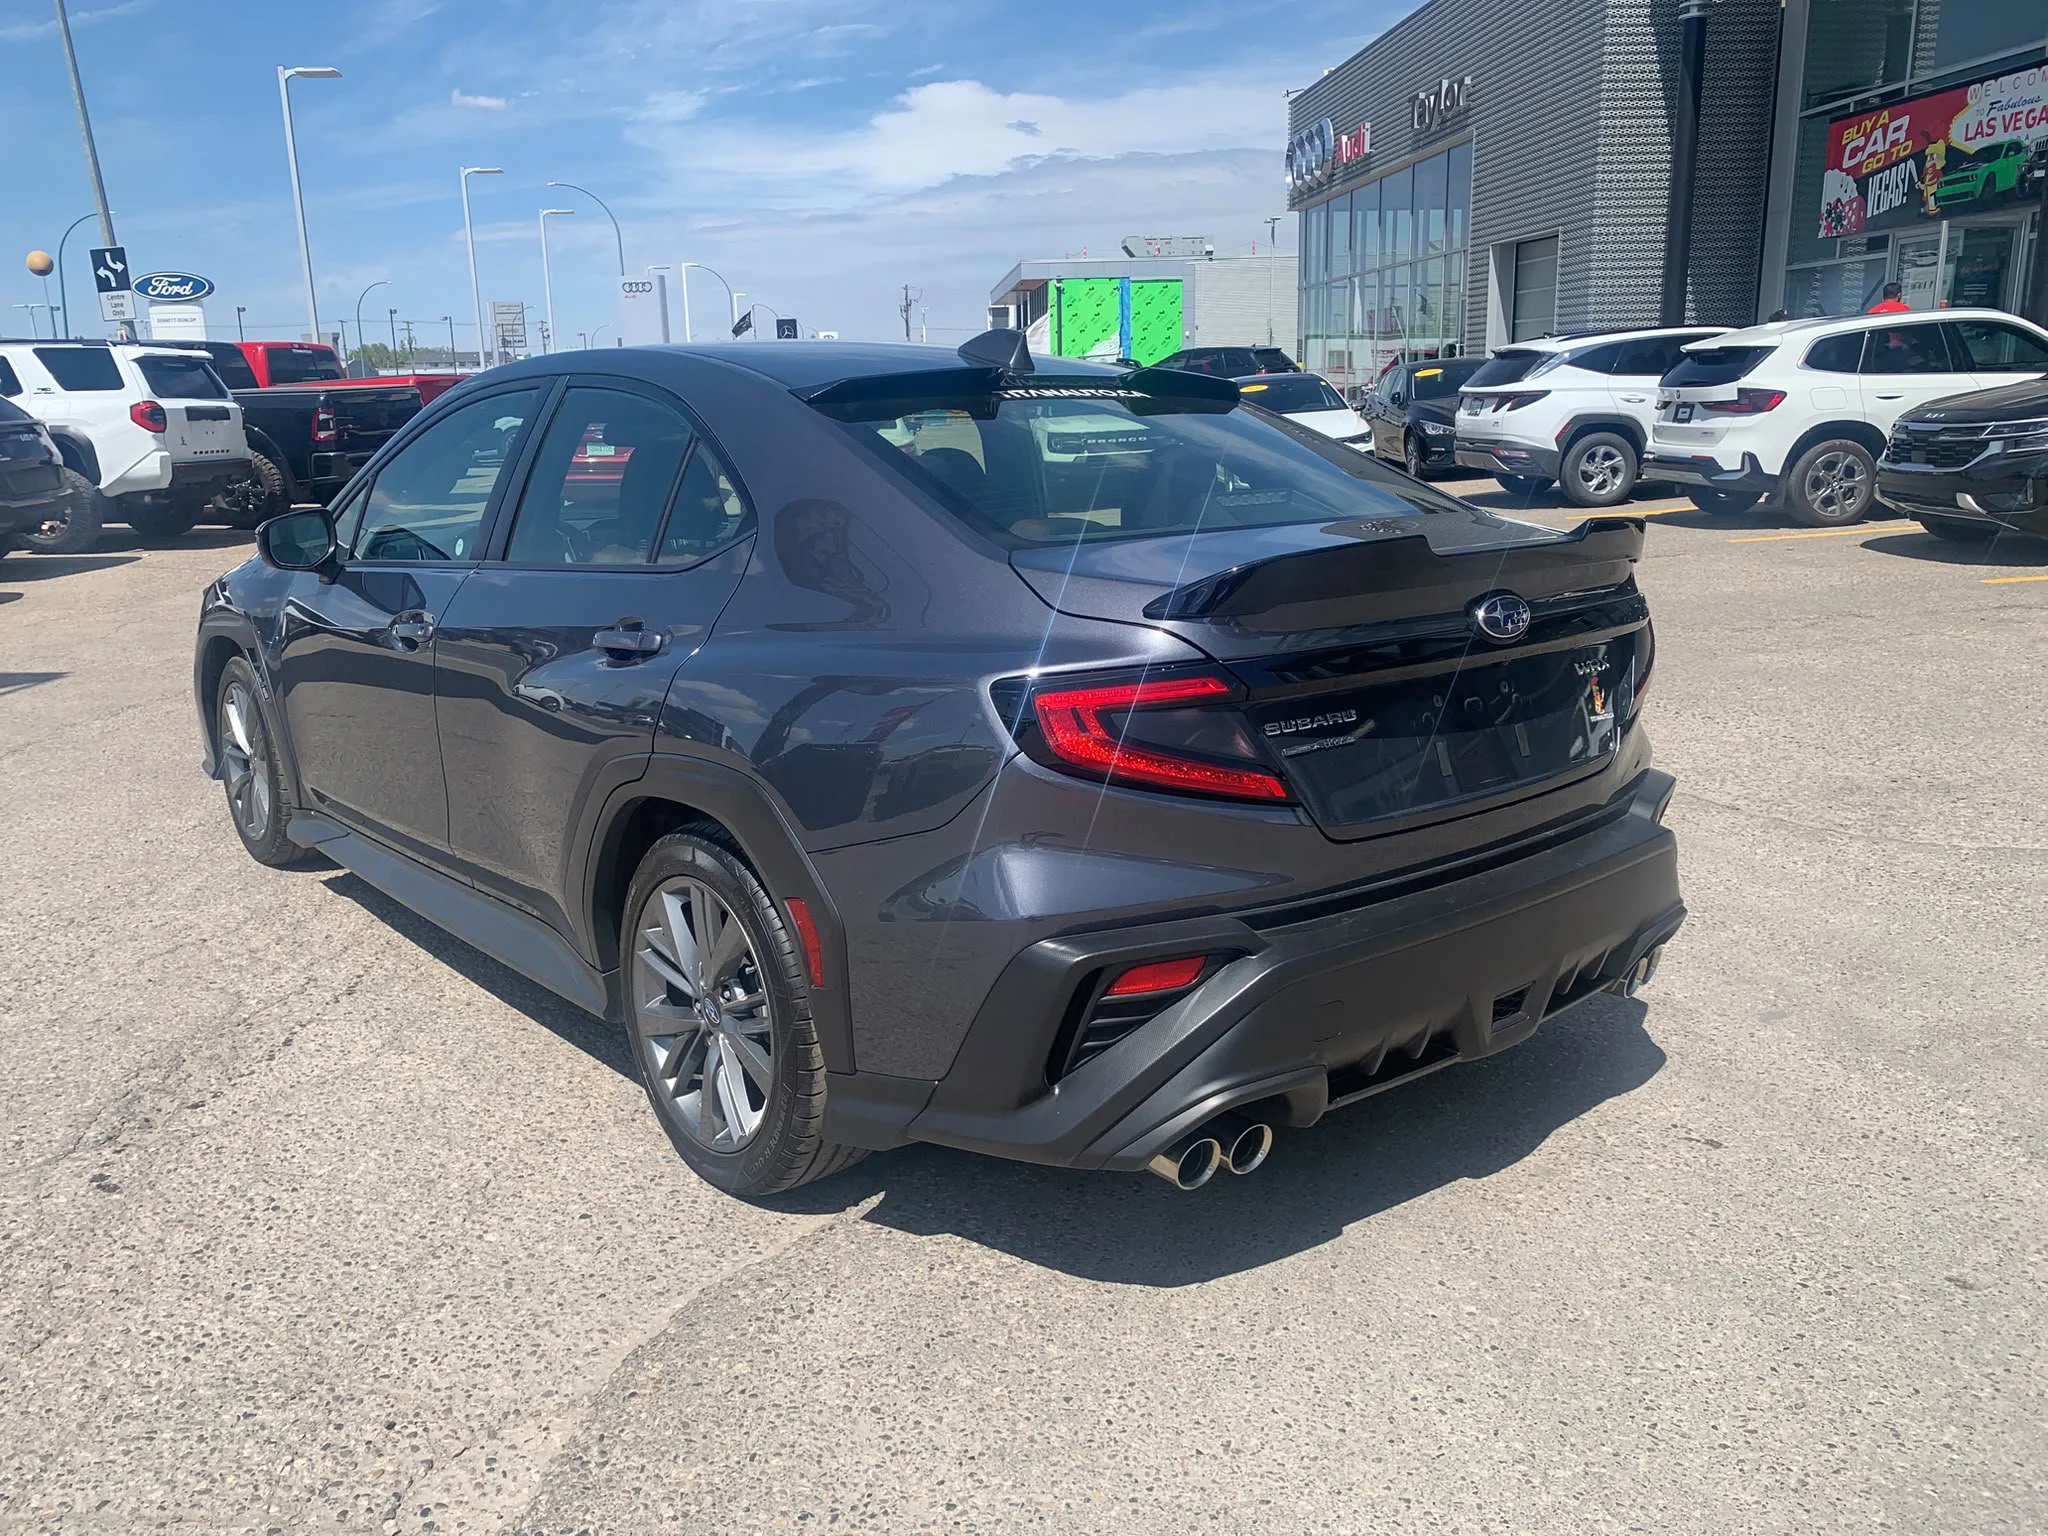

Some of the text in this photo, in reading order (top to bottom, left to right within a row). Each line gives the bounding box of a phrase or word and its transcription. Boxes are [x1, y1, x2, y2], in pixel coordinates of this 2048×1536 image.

[1410, 76, 1472, 132] Taylor
[1986, 95, 2043, 117] Fabulous
[1841, 110, 1889, 145] BUY A
[1842, 114, 1910, 169] CAR
[1964, 117, 1997, 142] LAS
[1335, 121, 1371, 165] Audi
[1862, 140, 1913, 174] GO TO
[1866, 162, 1909, 218] VEGAS!
[147, 276, 194, 295] Ford
[112, 309, 125, 317] Only
[1573, 655, 1611, 677] WRX
[1263, 709, 1358, 736] SUBARU
